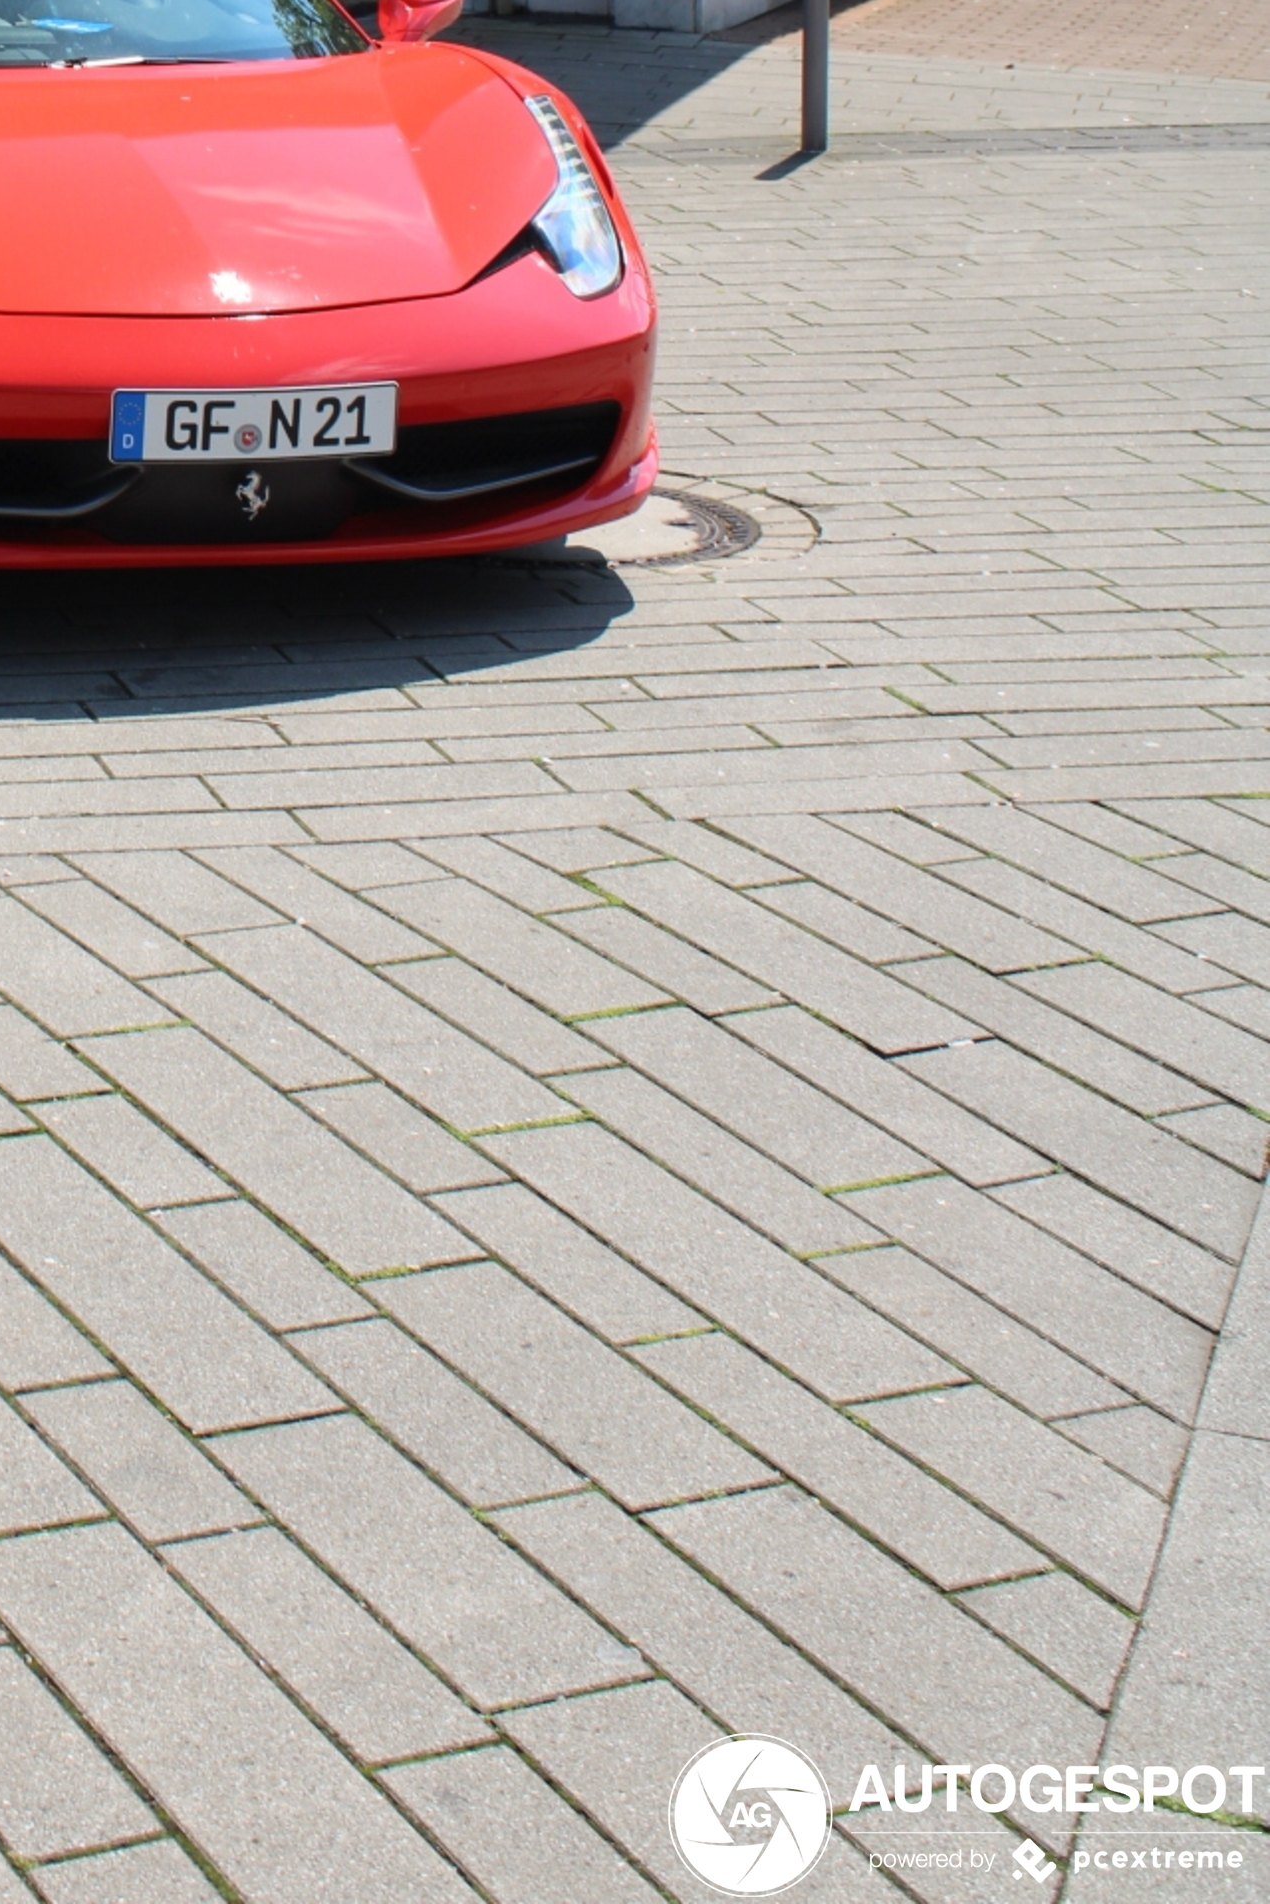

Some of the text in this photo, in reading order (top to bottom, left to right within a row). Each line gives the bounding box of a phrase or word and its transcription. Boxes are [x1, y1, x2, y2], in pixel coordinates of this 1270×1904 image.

[122, 395, 370, 451] D GF N 21
